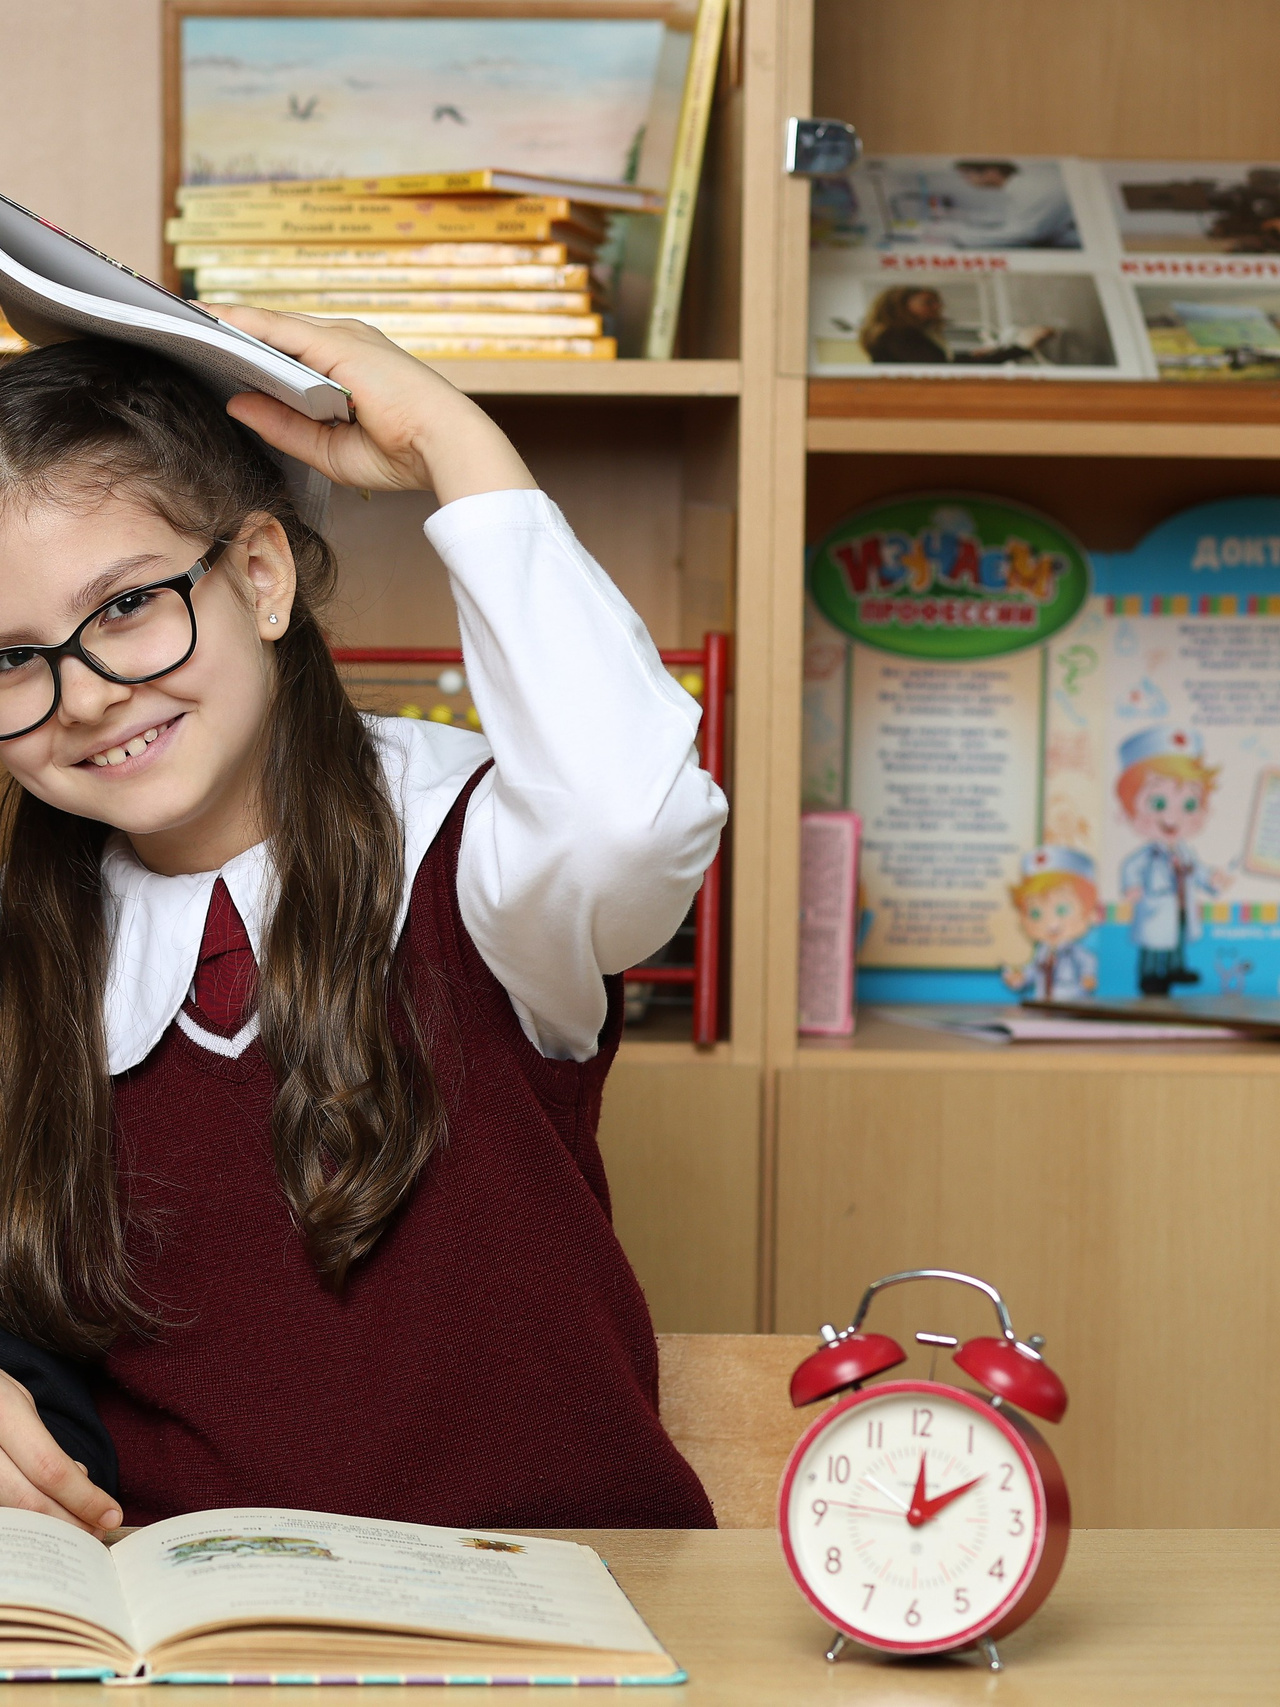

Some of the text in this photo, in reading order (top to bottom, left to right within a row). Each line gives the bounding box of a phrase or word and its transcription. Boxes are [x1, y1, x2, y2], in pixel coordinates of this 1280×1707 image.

[867, 1421, 884, 1449] 11
[911, 1408, 934, 1437] 12
[967, 1424, 974, 1454] 1
[827, 1455, 851, 1484] 10
[999, 1463, 1015, 1492] 2
[811, 1498, 829, 1528] 9
[1007, 1508, 1025, 1537] 3
[824, 1546, 842, 1575] 8
[987, 1555, 1008, 1582] 4
[862, 1583, 877, 1612] 7
[954, 1587, 971, 1615] 5
[904, 1599, 922, 1627] 6
